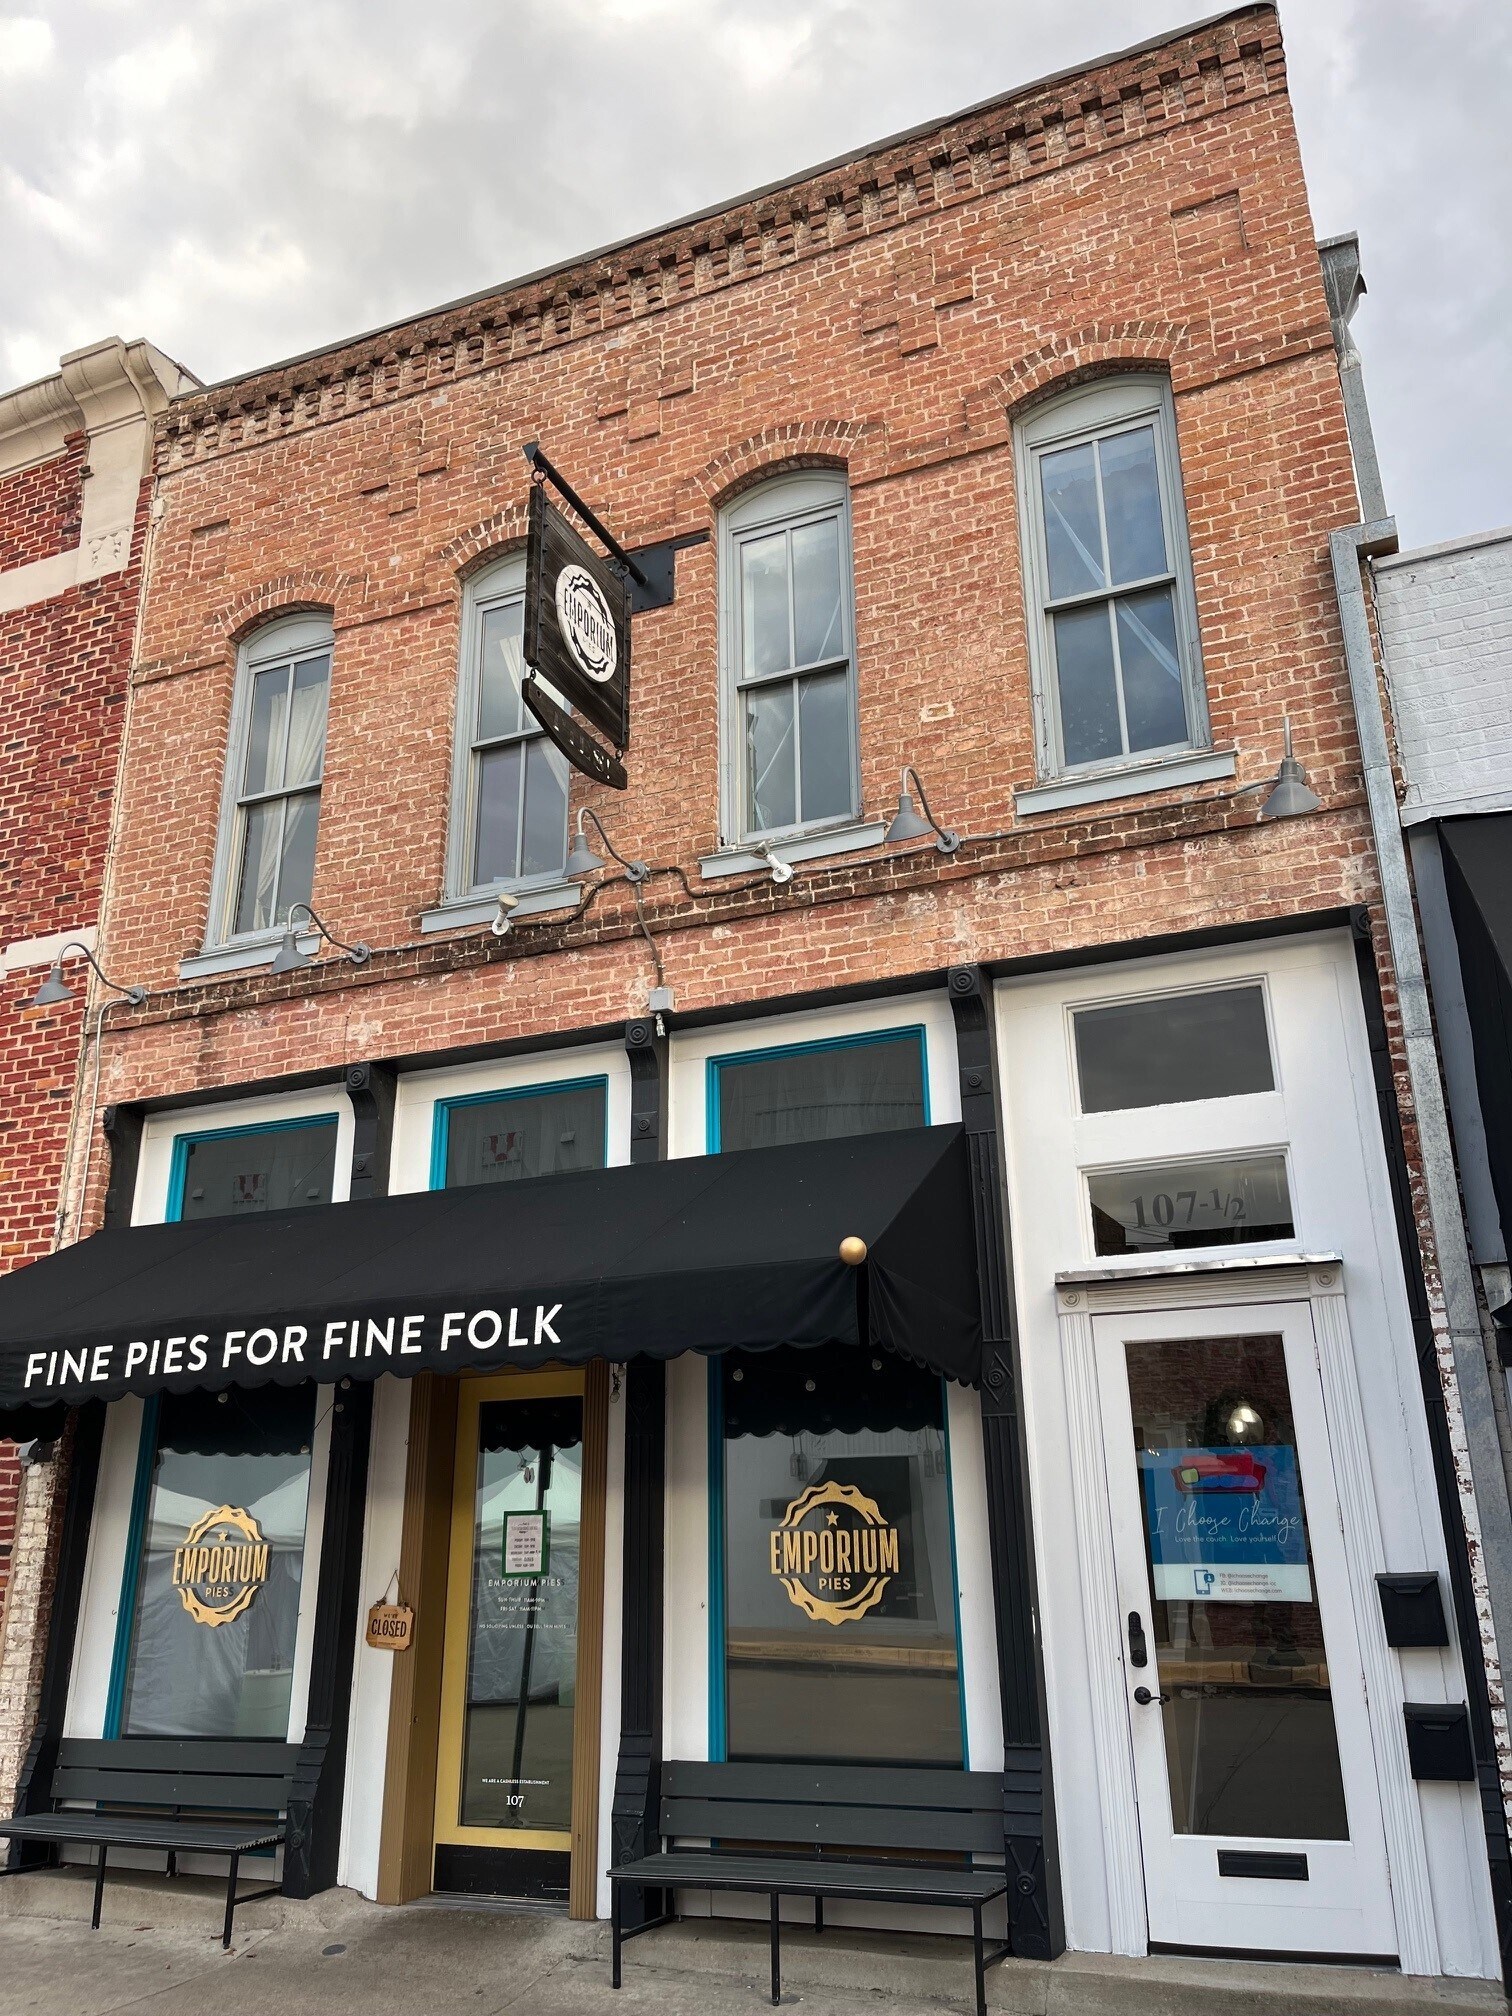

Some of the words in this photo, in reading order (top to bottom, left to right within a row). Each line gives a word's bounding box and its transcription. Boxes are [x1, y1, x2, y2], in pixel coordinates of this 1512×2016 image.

[24, 1344, 114, 1389] FINE
[124, 1333, 210, 1378] PIES
[222, 1325, 308, 1368] FOR
[322, 1314, 425, 1360] FINE
[440, 1303, 563, 1351] FOLK
[1151, 1506, 1169, 1535] I
[1175, 1500, 1232, 1535] Choose
[1238, 1499, 1301, 1544] Change
[1230, 1535, 1247, 1543] Love
[770, 1528, 899, 1575] EMPORIUM
[172, 1544, 269, 1585] EMPORIUM
[488, 1578, 537, 1587] EMPORIUM
[541, 1578, 561, 1587] PIES
[818, 1577, 852, 1591] PIES
[205, 1586, 229, 1598] PIES
[371, 1618, 407, 1638] CLOSED
[506, 1795, 525, 1808] 107
